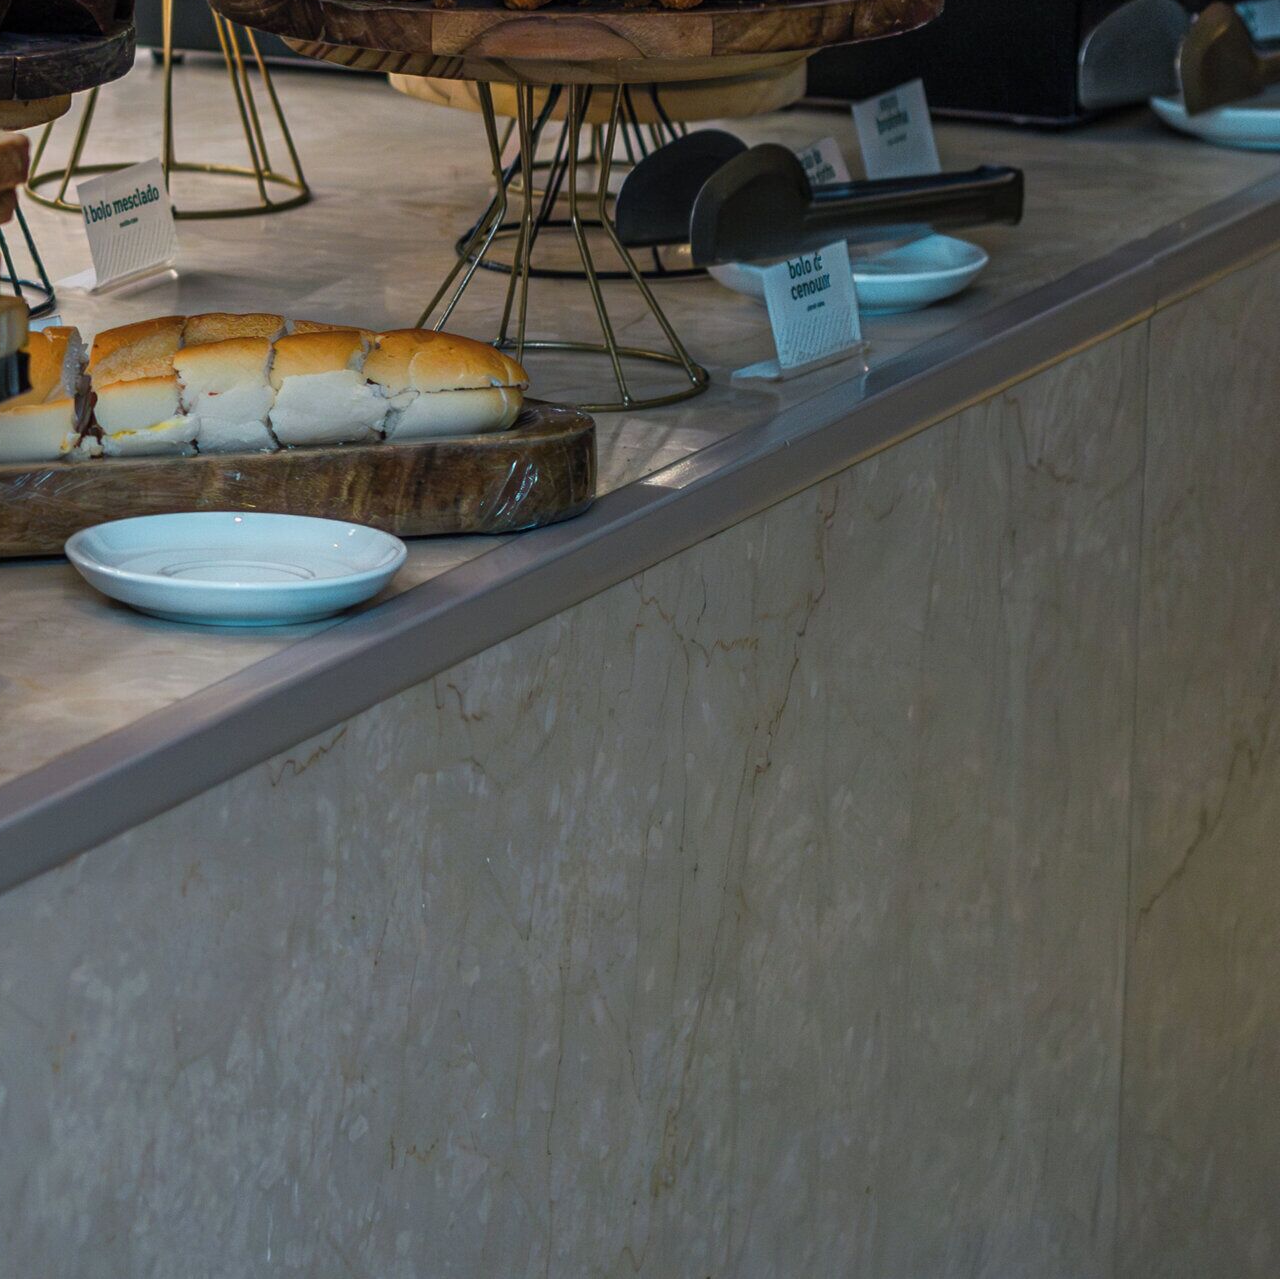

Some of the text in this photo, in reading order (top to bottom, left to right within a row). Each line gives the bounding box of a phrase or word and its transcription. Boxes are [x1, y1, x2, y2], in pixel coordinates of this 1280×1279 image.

[90, 200, 112, 223] bolo
[112, 183, 160, 214] mesclado
[787, 256, 812, 279] bolo
